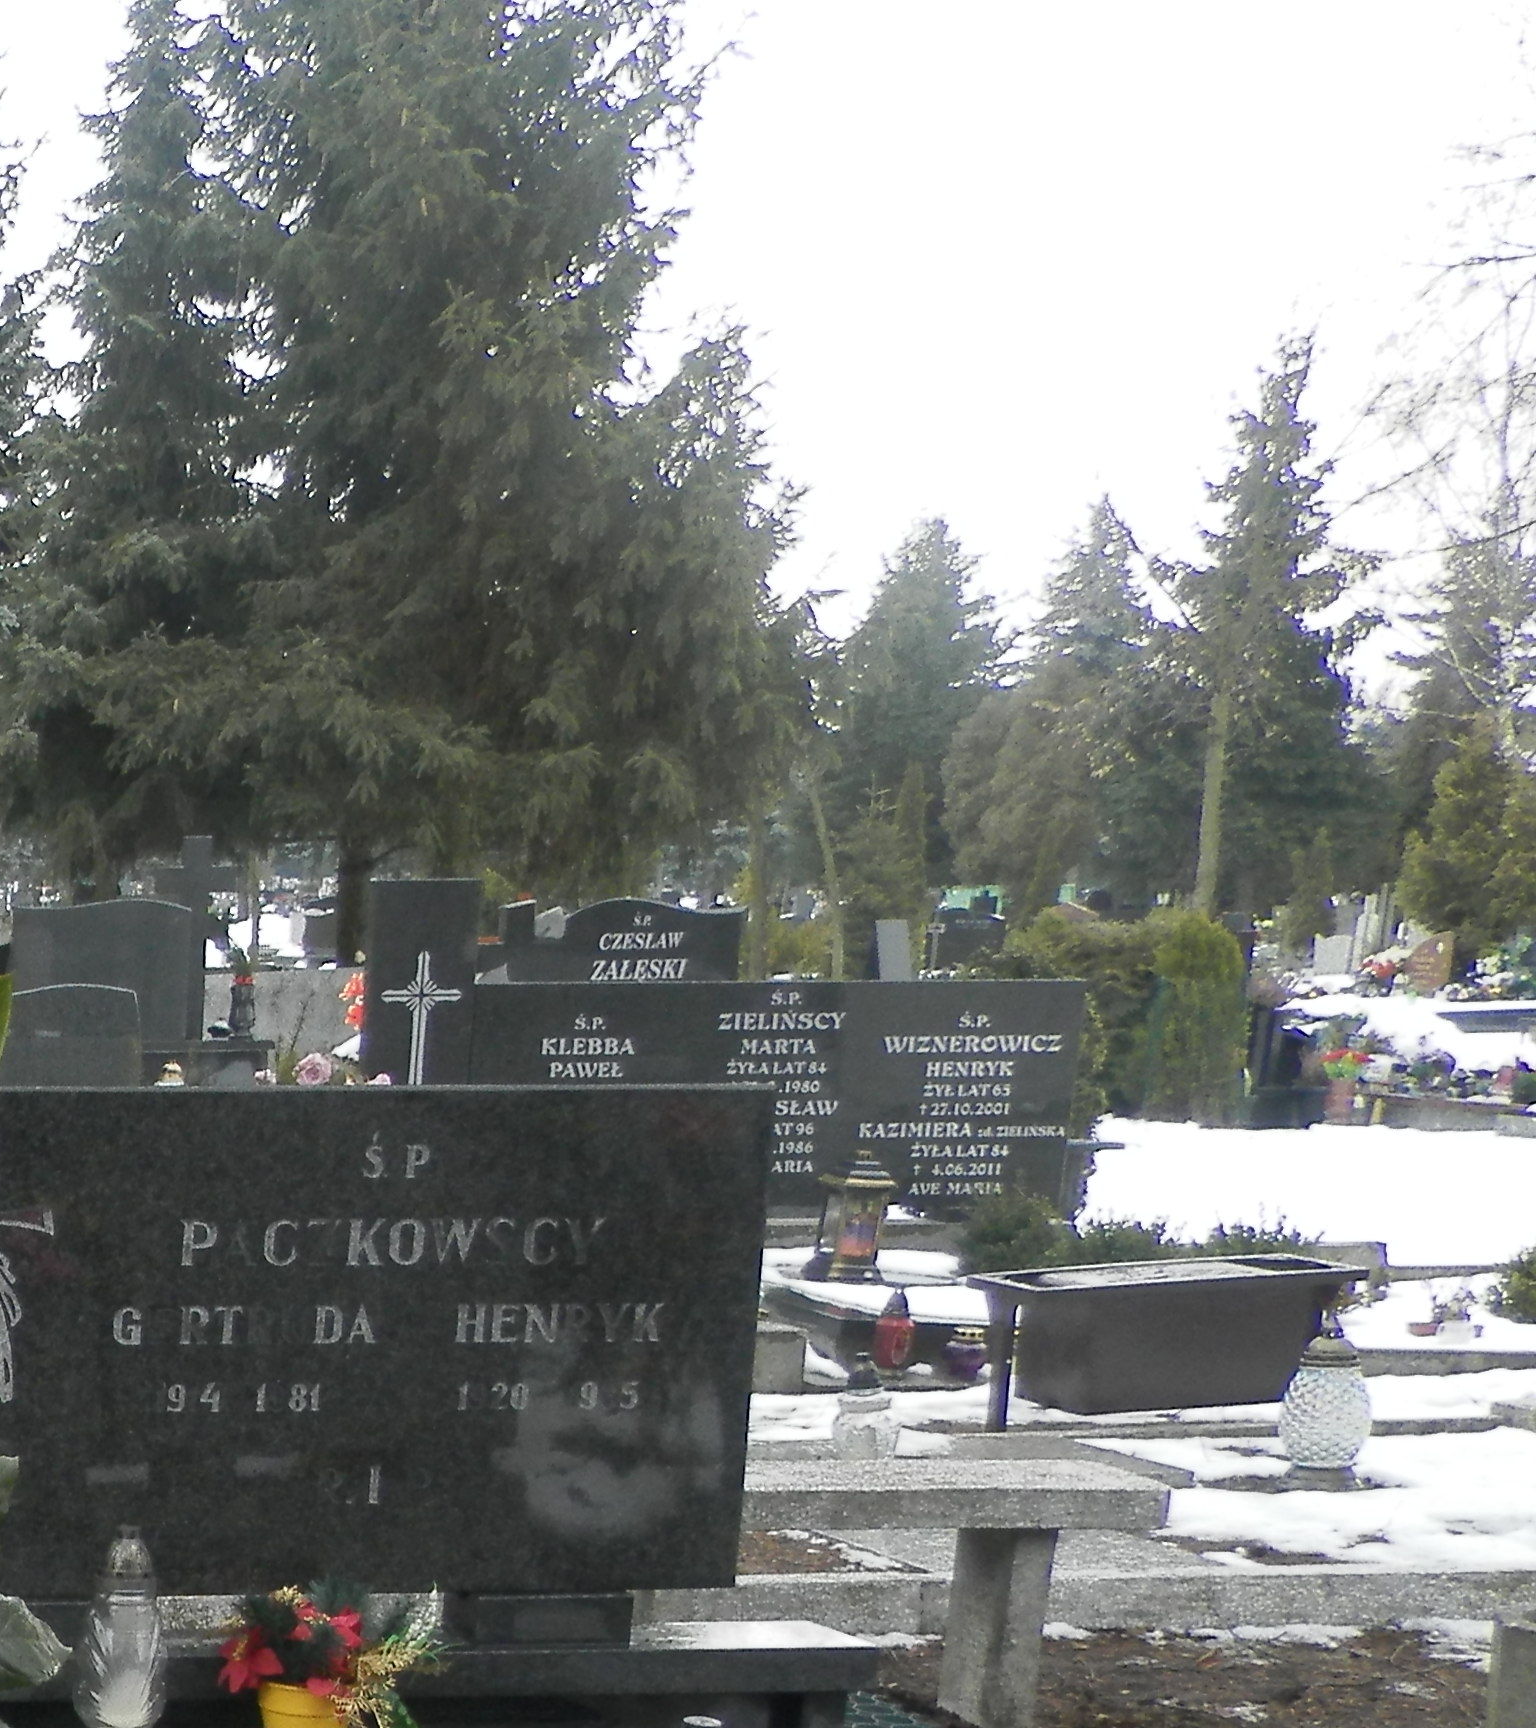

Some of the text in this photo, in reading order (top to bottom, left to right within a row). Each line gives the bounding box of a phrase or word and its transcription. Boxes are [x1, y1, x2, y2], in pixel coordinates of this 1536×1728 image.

[718, 1010, 847, 1031] ZIELIŃSCY
[540, 1037, 635, 1056] KLEBBA
[740, 1039, 817, 1055] MARTA
[884, 1034, 1064, 1054] WIZNEROWICZ
[549, 1061, 624, 1079] PAWEŁ
[772, 1061, 806, 1075] LAT
[925, 1061, 1015, 1077] HENRYK
[957, 1084, 990, 1097] LAT
[774, 1099, 839, 1116] SŁAW
[773, 1122, 815, 1136] AT 96
[858, 1122, 972, 1139] KAZIMIERA
[772, 1141, 814, 1155] .1986
[910, 1142, 953, 1158] ŻYŁA
[955, 1144, 989, 1158] LAT
[771, 1160, 814, 1173] ARIA
[907, 1182, 942, 1196] AVE
